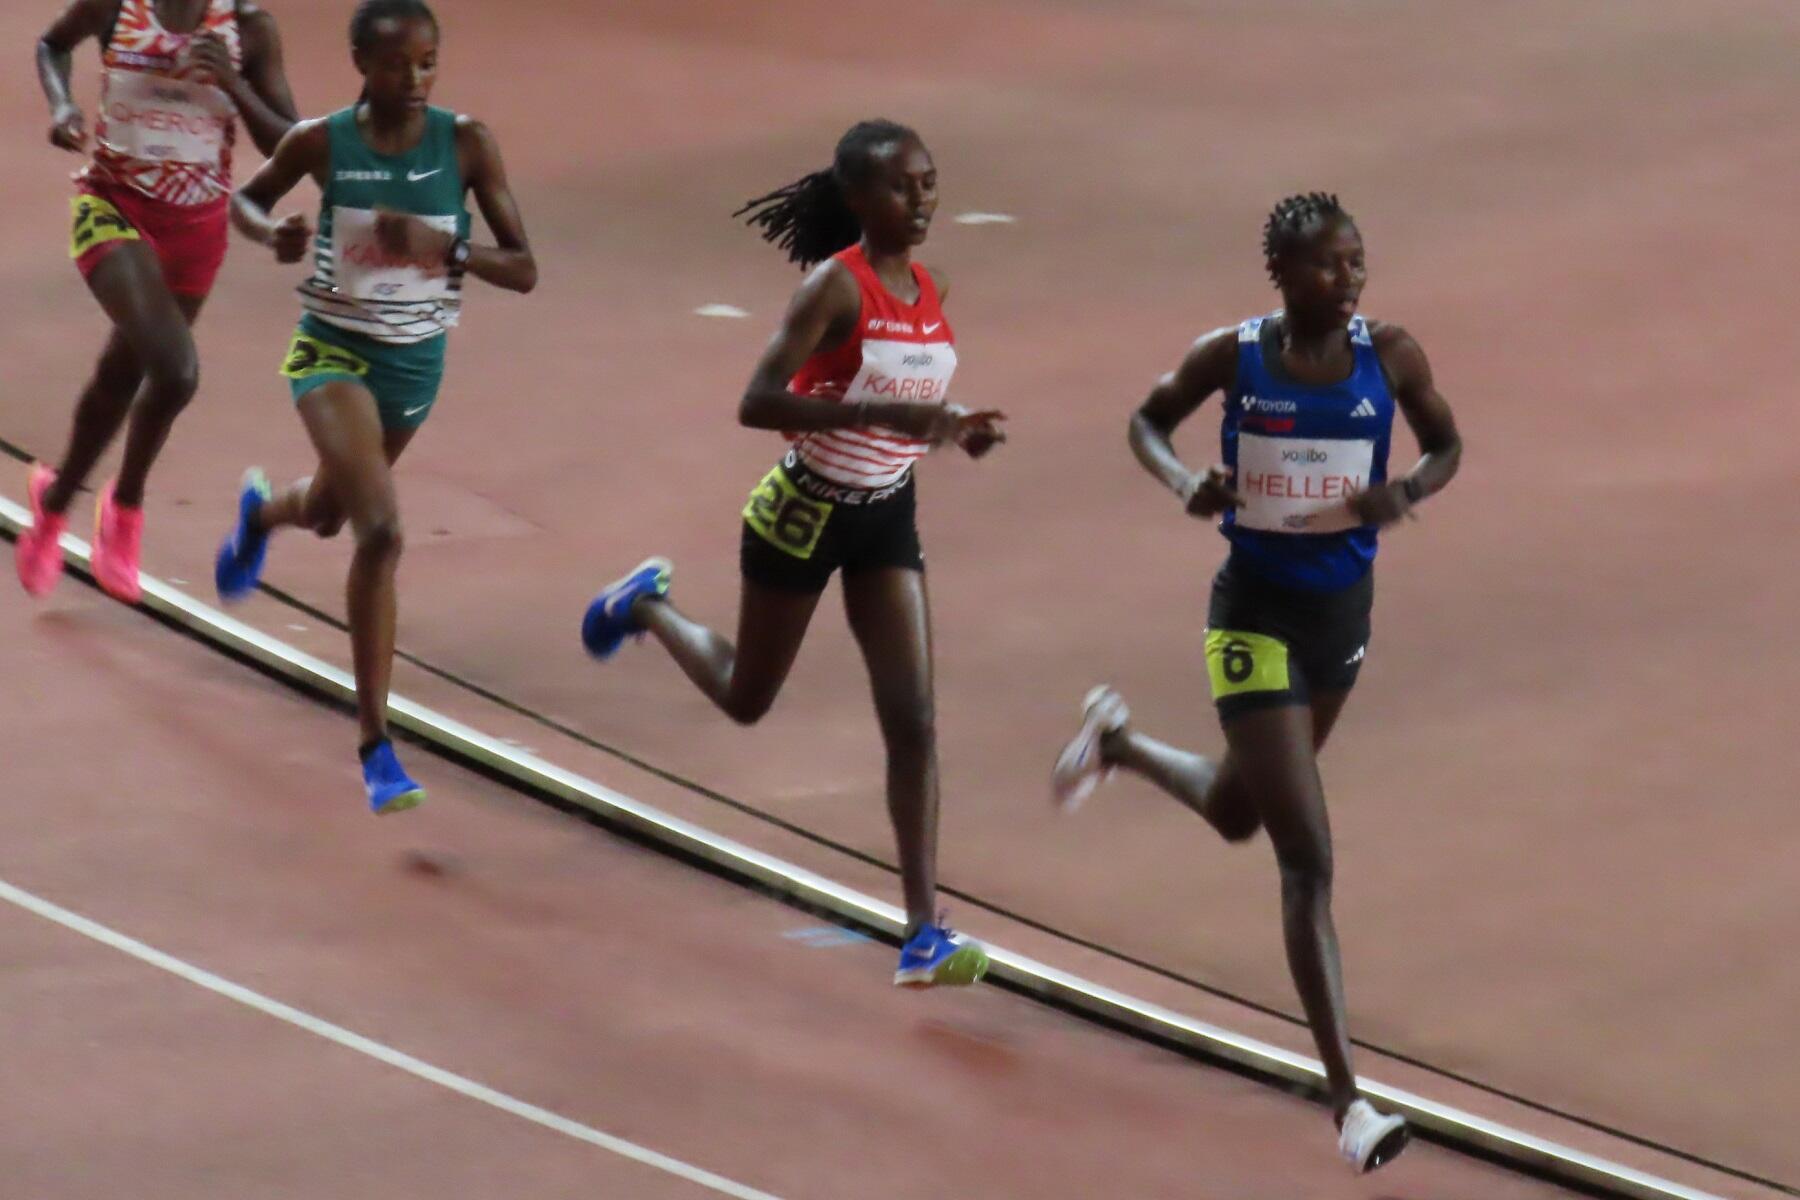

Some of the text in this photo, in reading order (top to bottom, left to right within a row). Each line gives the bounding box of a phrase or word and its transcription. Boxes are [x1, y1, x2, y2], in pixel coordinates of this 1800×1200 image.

[1256, 399, 1297, 413] TOYOTA
[1245, 471, 1361, 500] HELLEN
[1222, 638, 1254, 684] 6
